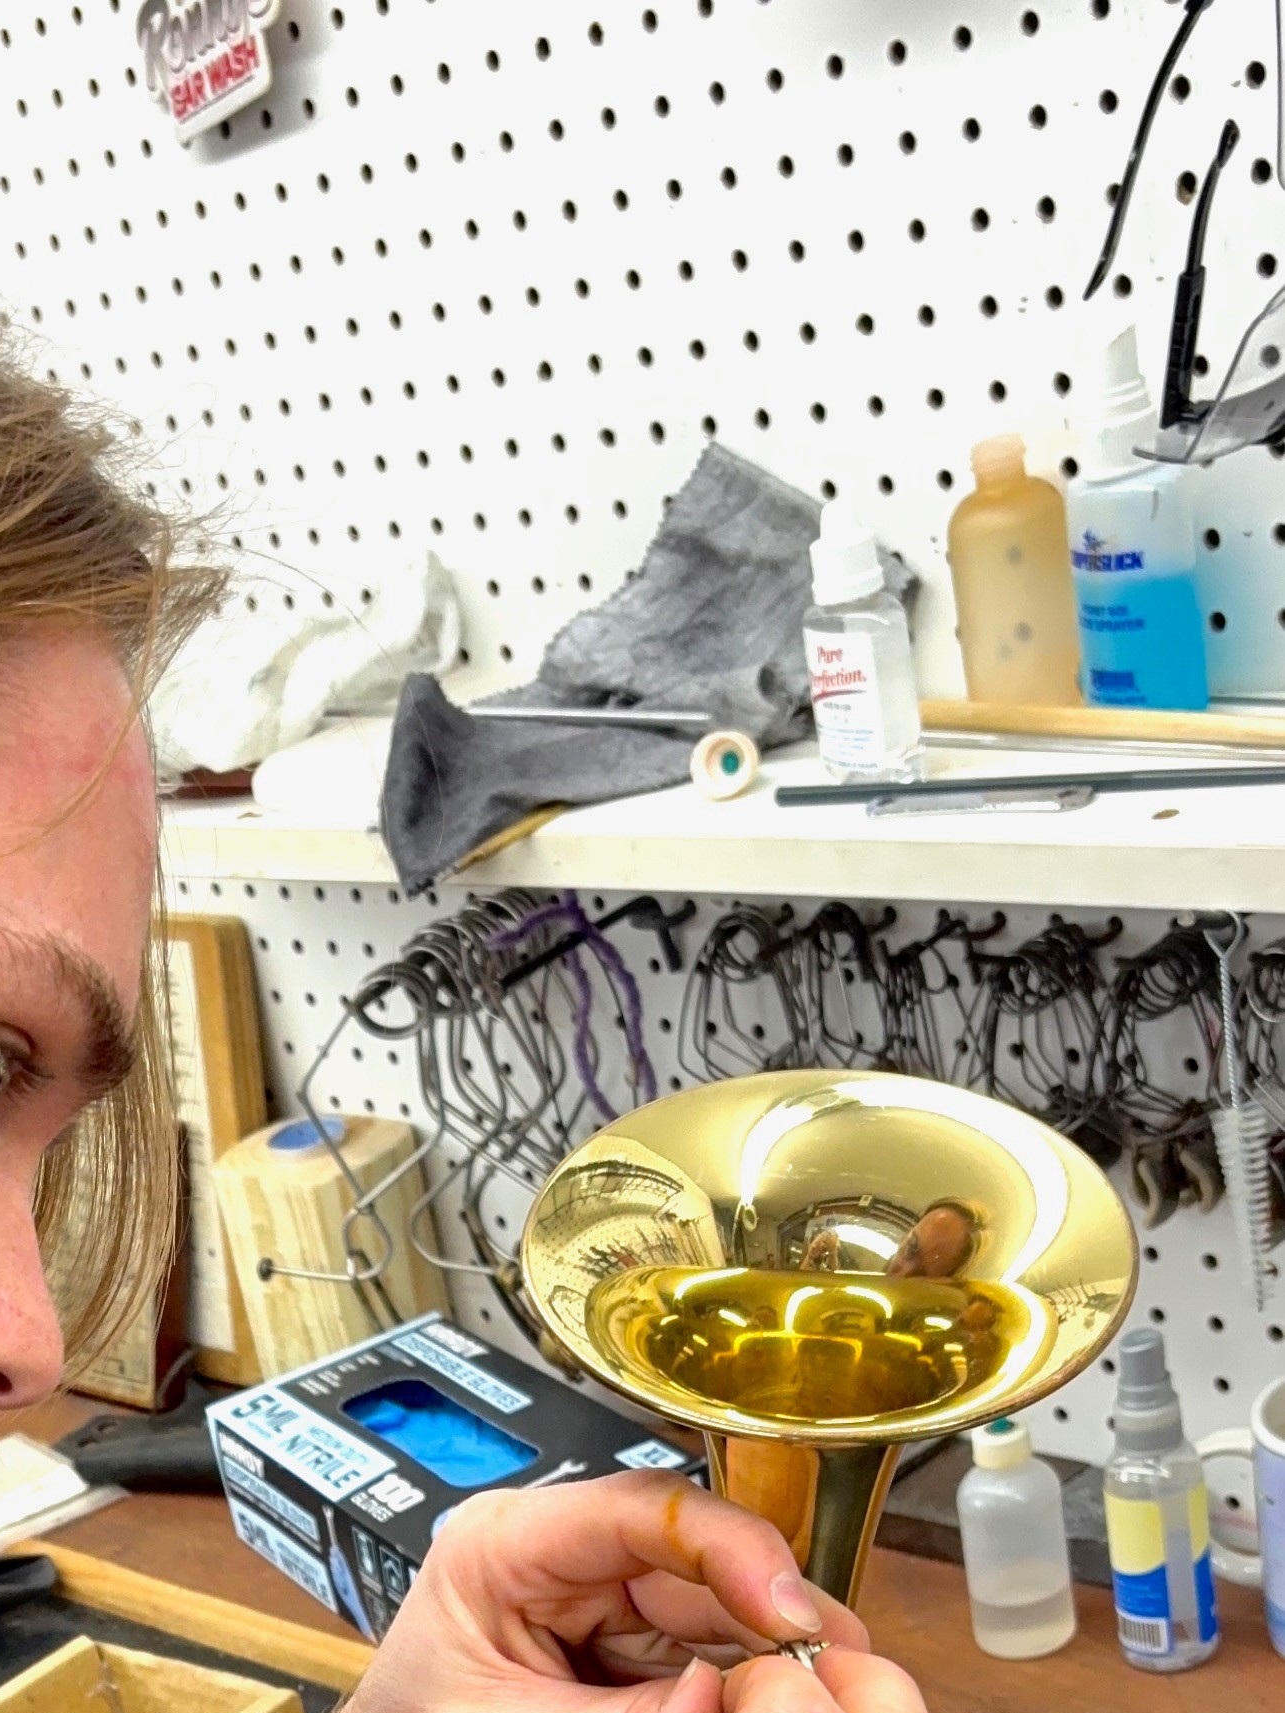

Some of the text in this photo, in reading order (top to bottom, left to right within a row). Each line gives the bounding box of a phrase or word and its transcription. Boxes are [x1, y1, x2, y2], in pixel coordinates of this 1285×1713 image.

[817, 646, 843, 664] Pure
[277, 1433, 362, 1490] NITRILE
[367, 1472, 426, 1514] 100
